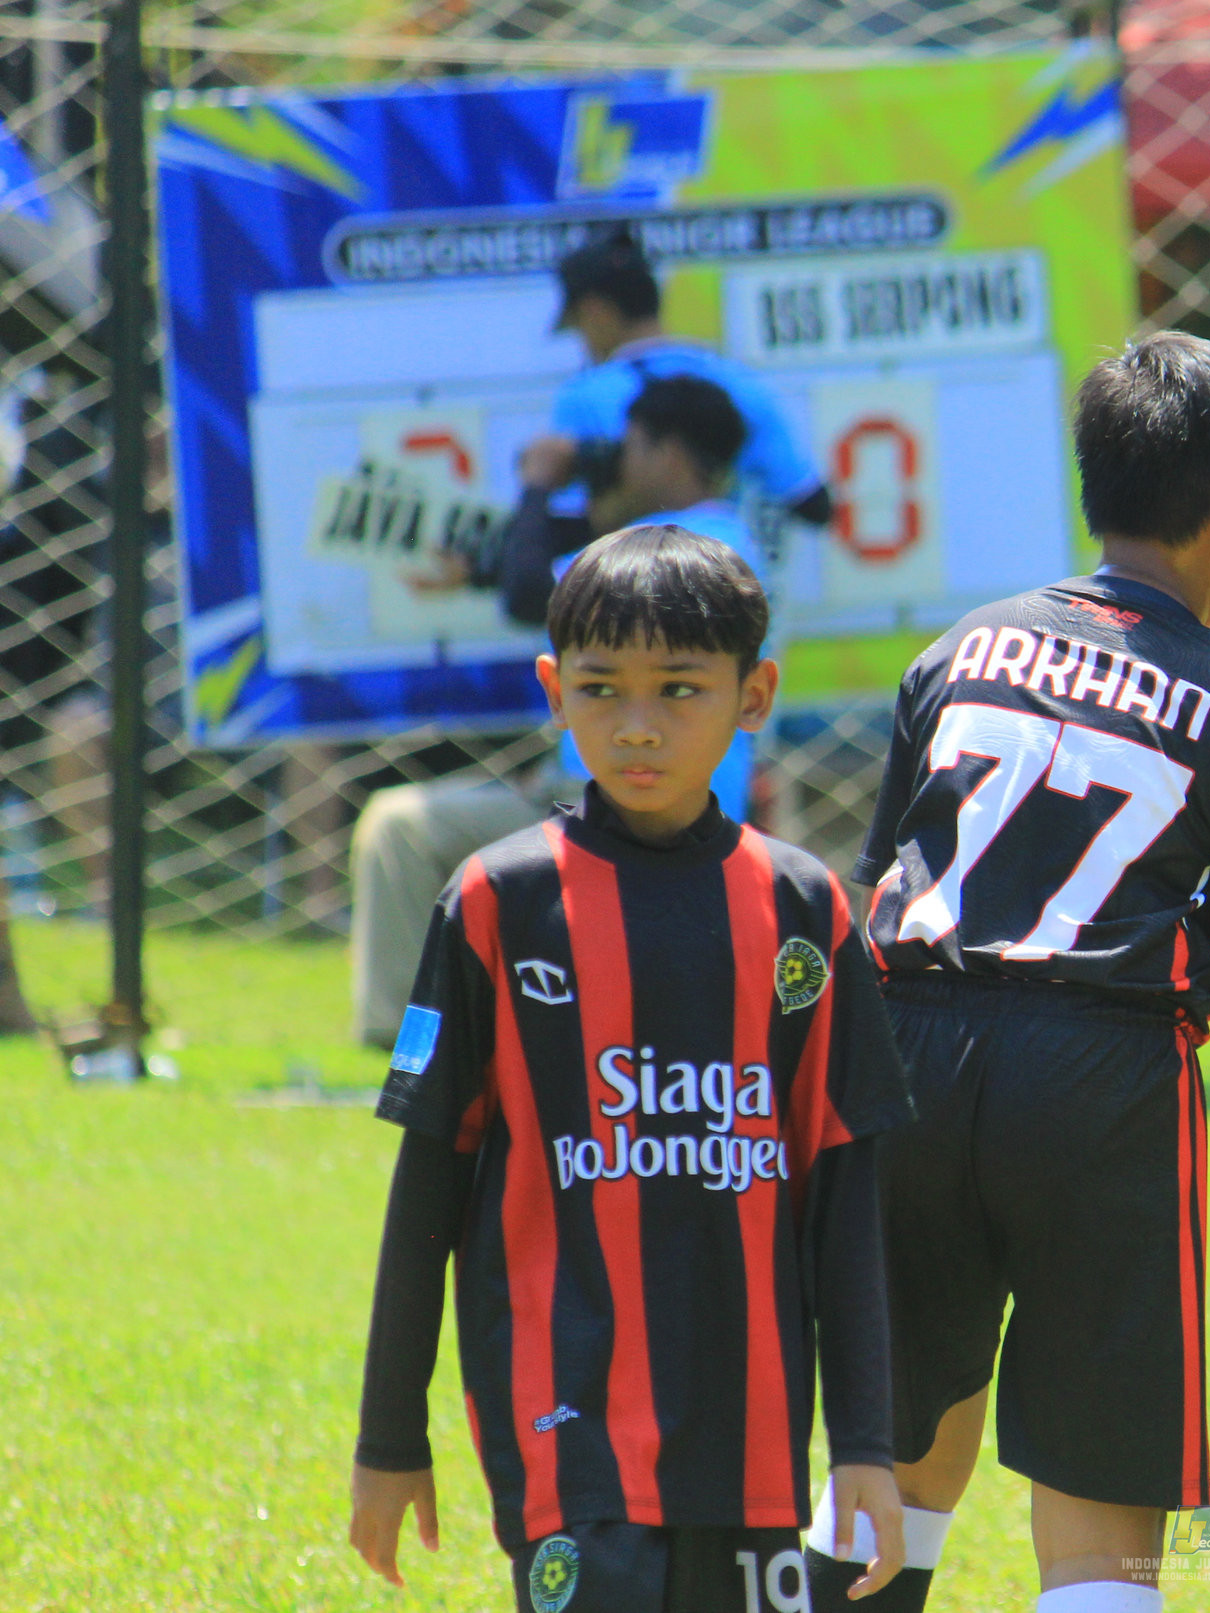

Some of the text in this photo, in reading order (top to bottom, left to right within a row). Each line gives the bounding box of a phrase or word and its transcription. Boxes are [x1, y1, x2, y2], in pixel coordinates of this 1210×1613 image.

[897, 702, 1195, 960] 77
[598, 1046, 772, 1134] Siaga
[736, 1550, 813, 1613] 19
